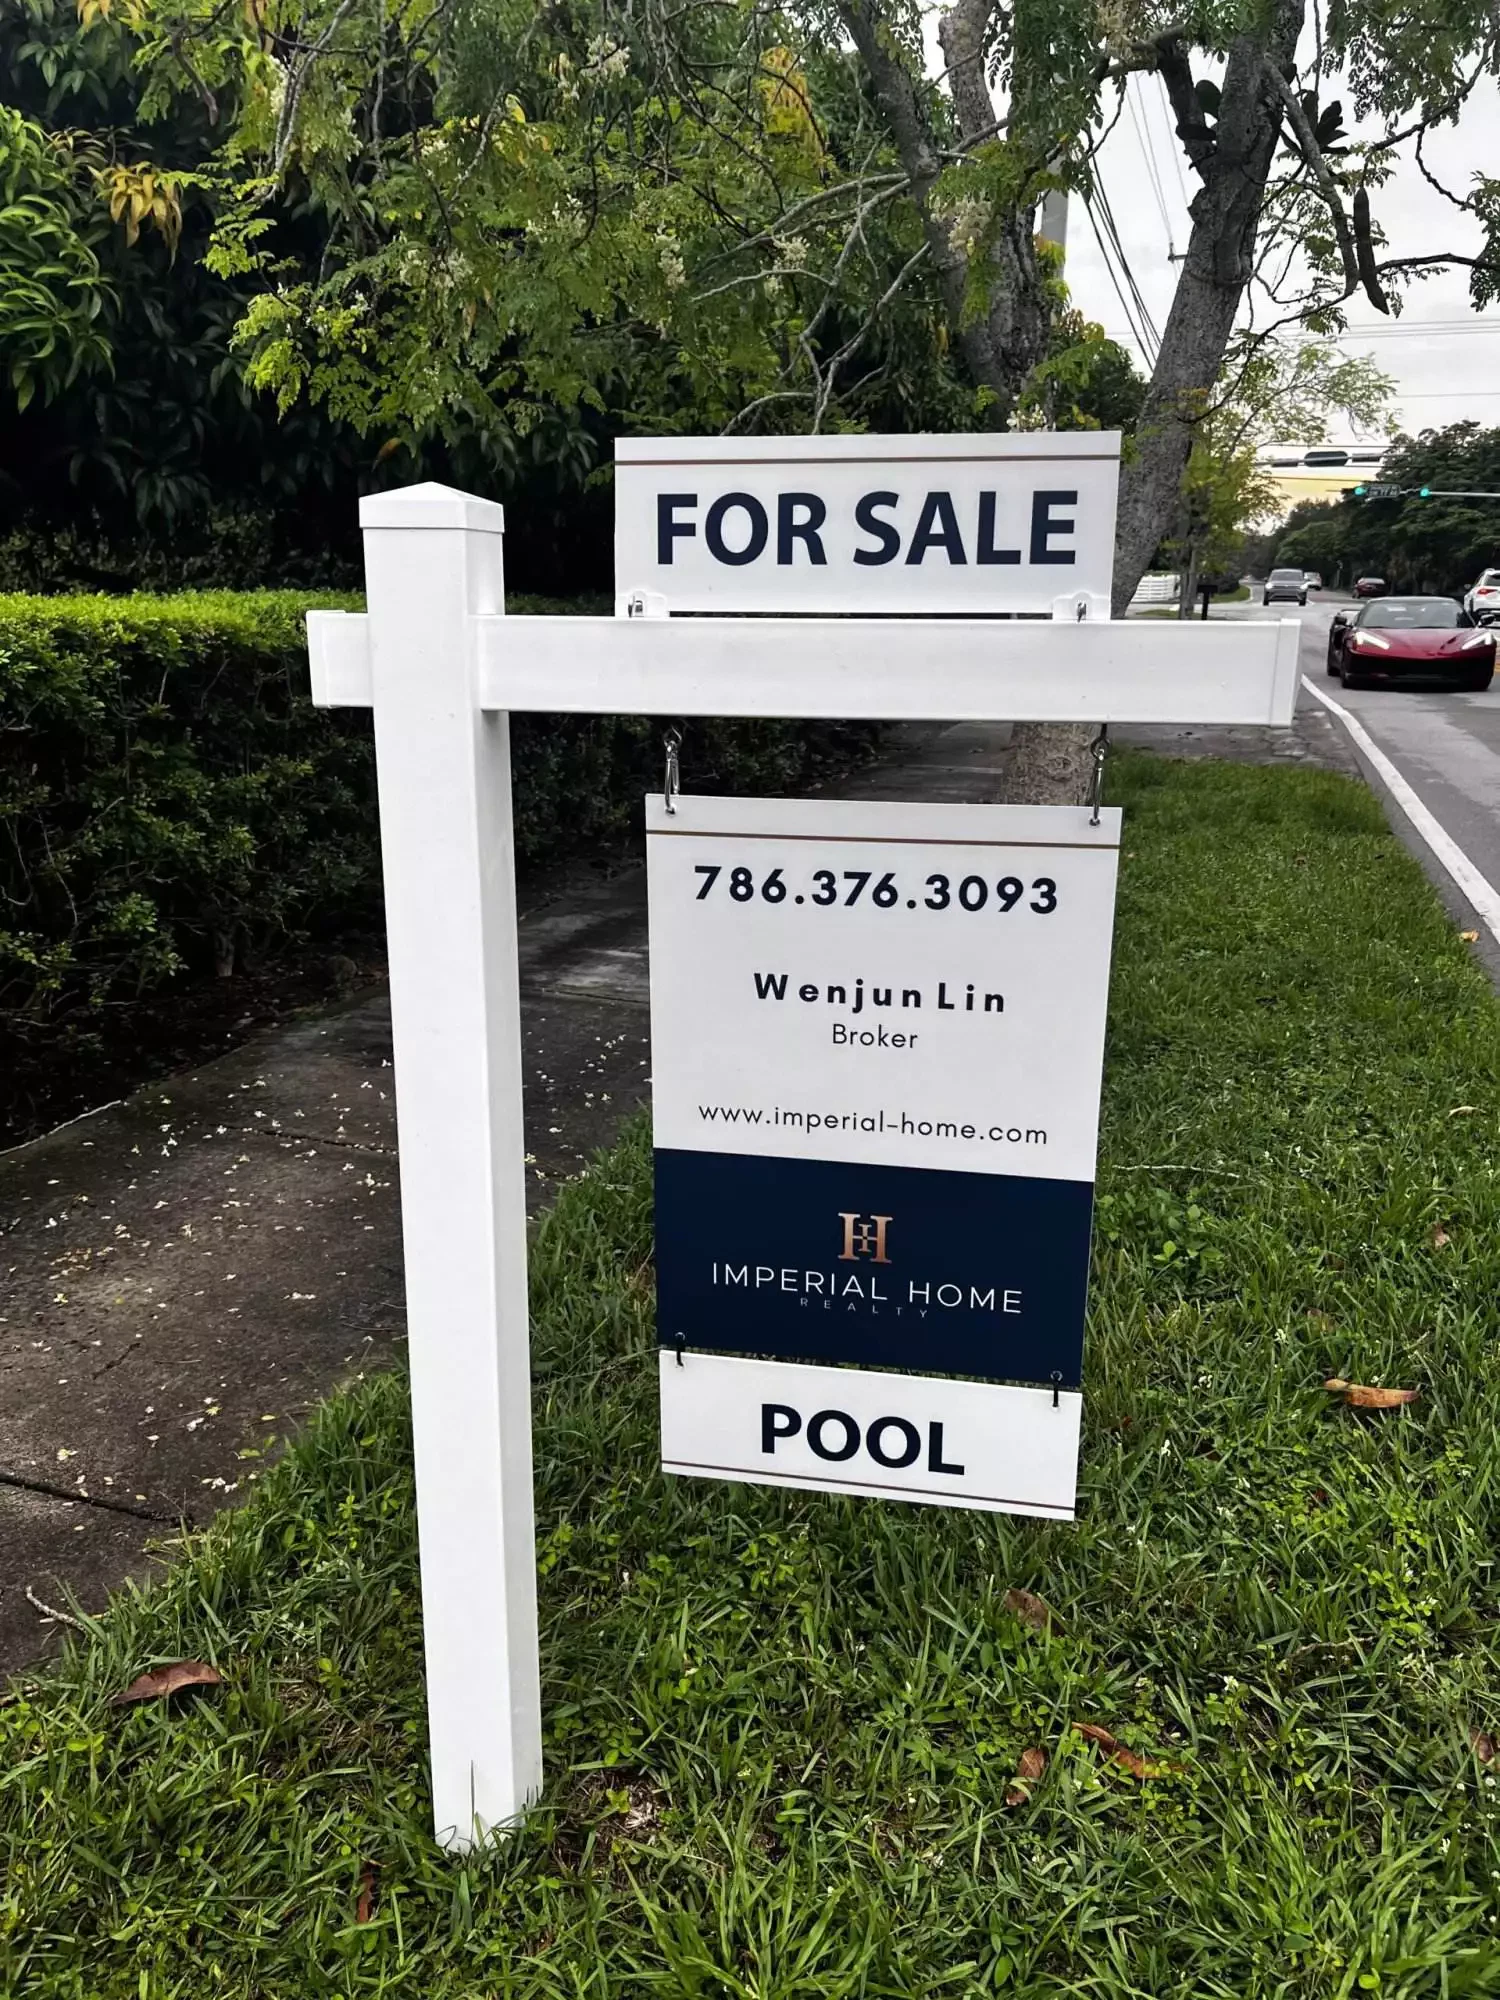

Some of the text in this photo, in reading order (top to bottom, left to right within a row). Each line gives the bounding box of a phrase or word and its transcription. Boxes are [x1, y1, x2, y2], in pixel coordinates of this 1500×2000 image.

[657, 490, 1078, 566] FOR SALE
[695, 866, 1057, 914] 786.376.3093
[754, 973, 1004, 1013] Wenjun Lin
[832, 1024, 918, 1048] Broker
[698, 1105, 1047, 1144] www.imperial-home.com
[713, 1262, 1022, 1313] IMPERIAL HOME
[800, 1297, 927, 1318] REALTY
[760, 1404, 965, 1475] POOL
